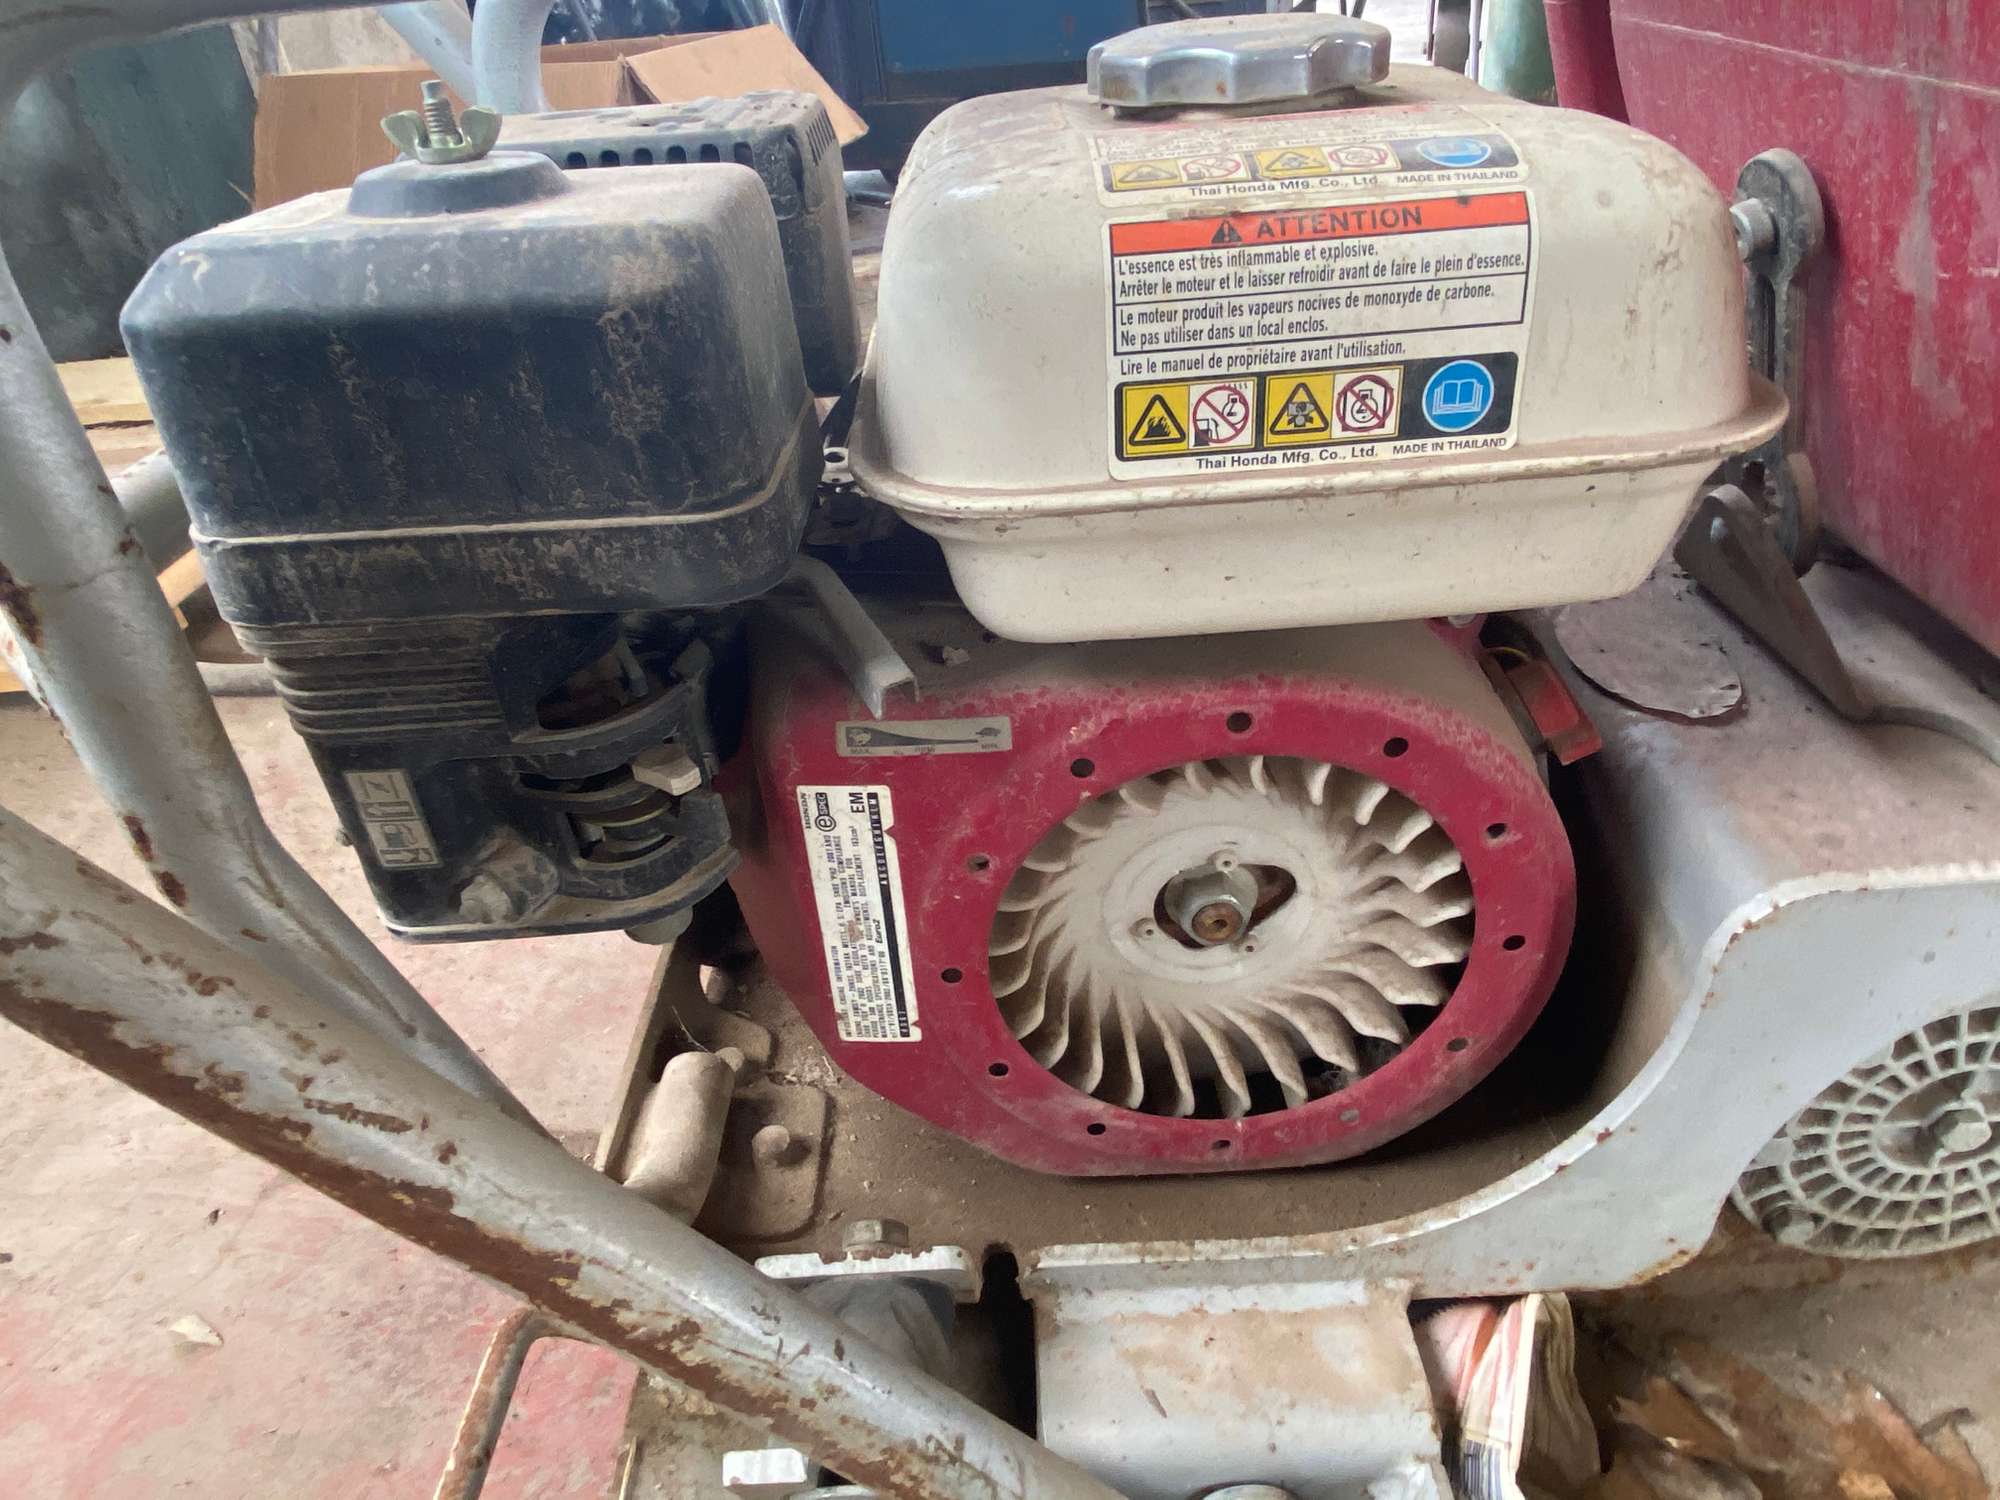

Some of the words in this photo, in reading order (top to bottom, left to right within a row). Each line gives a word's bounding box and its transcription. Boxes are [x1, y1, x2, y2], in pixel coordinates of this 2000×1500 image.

[1226, 182, 1275, 194] Honda
[1396, 174, 1434, 184] MADE
[1438, 174, 1450, 182] IN
[1452, 170, 1518, 181] THAILAND
[1257, 206, 1422, 238] ATTENTION
[1118, 258, 1174, 276] L'essence
[1179, 256, 1196, 272] est
[1200, 254, 1222, 269] très
[1227, 246, 1299, 268] inflammable
[1304, 246, 1316, 260] et
[1320, 241, 1378, 262] explosive.
[1120, 280, 1158, 298] Arrêter
[1162, 278, 1172, 294] le
[1176, 276, 1214, 292] moteur
[1220, 274, 1230, 290] et
[1234, 273, 1244, 288] le
[1249, 270, 1284, 288] laisser
[1289, 264, 1334, 283] refroidir
[1339, 264, 1369, 280] avant
[1373, 261, 1386, 278] de
[1391, 260, 1416, 276] faire
[1420, 258, 1430, 274] le
[1435, 255, 1463, 276] plein
[1467, 252, 1524, 270] d'essence.
[1120, 310, 1133, 326] Le
[1138, 308, 1177, 324] moteur
[1182, 302, 1224, 327] produit
[1228, 302, 1244, 318] les
[1248, 300, 1293, 319] vapeurs
[1298, 294, 1340, 312] nocives
[1345, 292, 1359, 308] de
[1364, 286, 1422, 309] monoxyde
[1426, 285, 1440, 300] de
[1444, 282, 1494, 300] carbone.
[1120, 331, 1136, 347] Ne
[1140, 332, 1160, 350] pas
[1164, 326, 1203, 344] utiliser
[1208, 324, 1234, 340] dans
[1239, 324, 1253, 338] un
[1258, 319, 1283, 336] local
[1288, 316, 1328, 334] enclos.
[1120, 360, 1142, 376] Lire
[1147, 358, 1157, 374] le
[1162, 354, 1204, 372] manuel
[1208, 352, 1222, 368] de
[1227, 347, 1296, 372] propriétaire
[1300, 344, 1332, 361] avant
[1338, 338, 1406, 358] l'utilisation.
[1196, 457, 1226, 470] Thai
[1231, 454, 1278, 467] Honda
[1282, 451, 1314, 464] Mfg.
[1319, 449, 1346, 461] Co.,
[1352, 446, 1378, 458] Ltd.
[1392, 443, 1428, 454] MADE
[1432, 442, 1444, 452] IN
[1448, 438, 1507, 450] THAILAND
[848, 792, 866, 813] EM
[872, 919, 883, 944] Euro2
